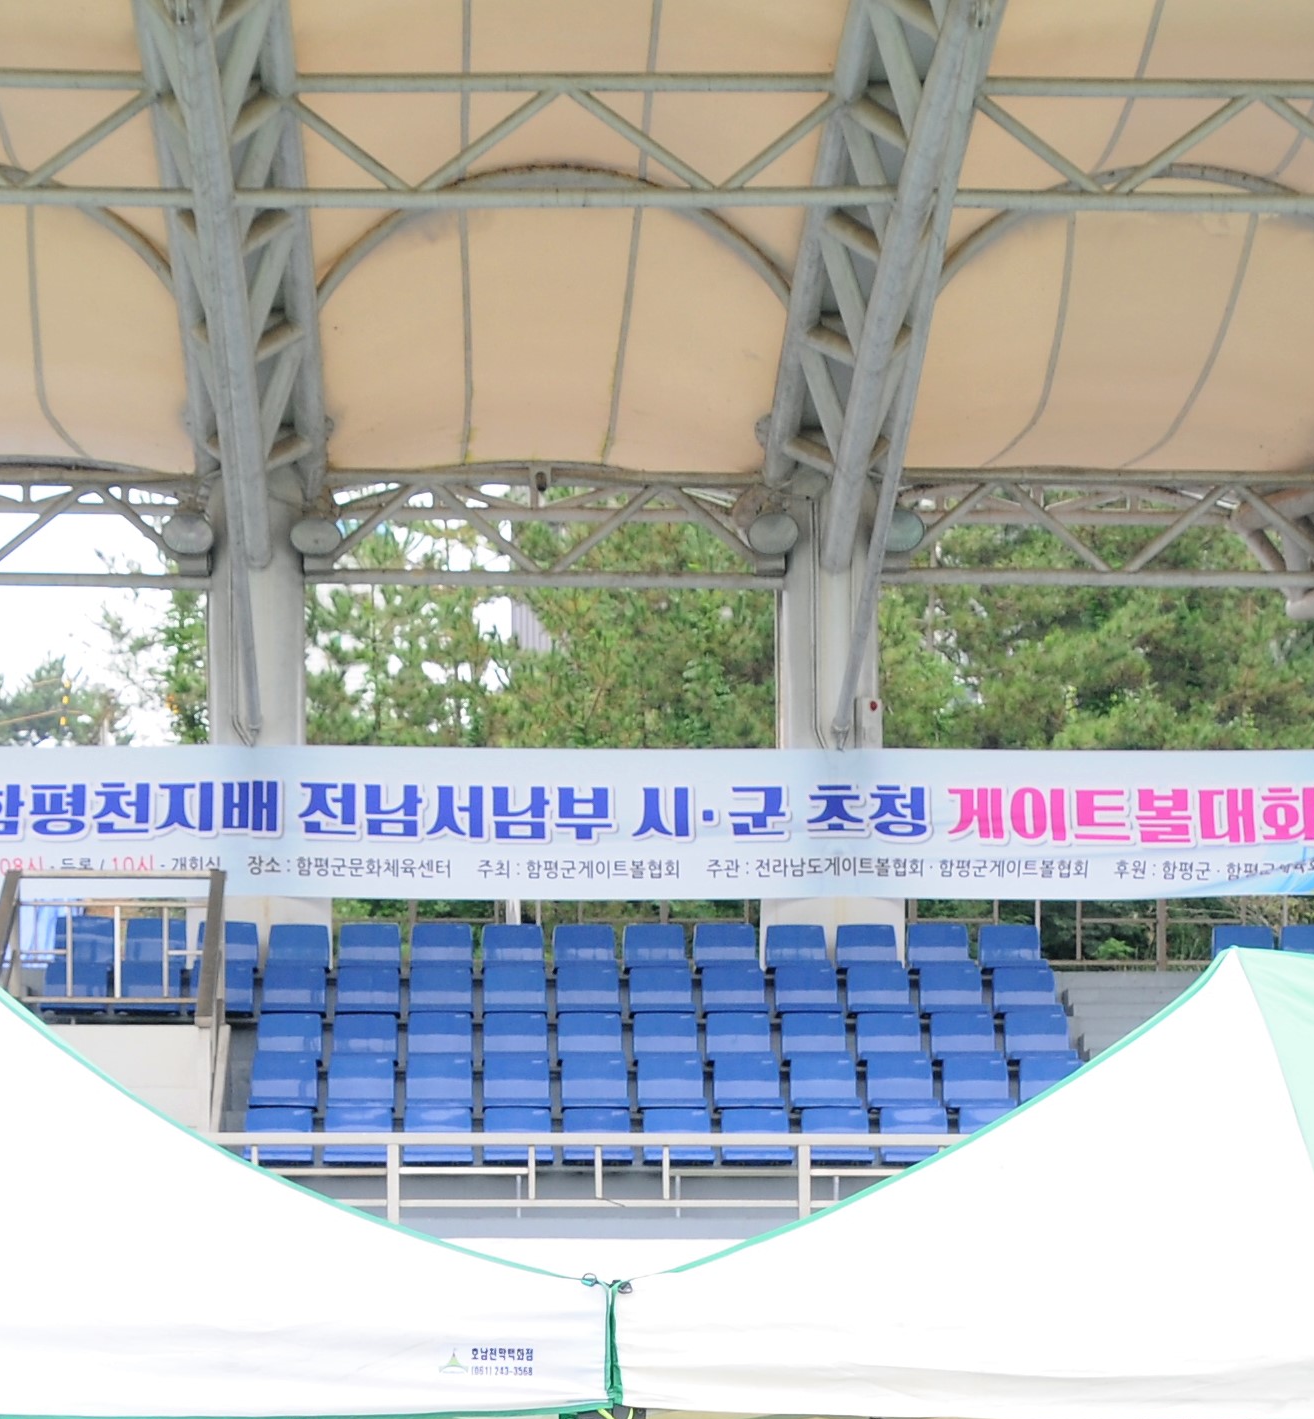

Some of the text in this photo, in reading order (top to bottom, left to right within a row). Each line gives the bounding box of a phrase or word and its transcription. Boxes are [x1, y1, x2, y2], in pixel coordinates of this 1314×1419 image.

[298, 782, 613, 840] 전남서남부
[806, 784, 927, 837] 초청
[247, 855, 282, 876] 장소
[297, 857, 452, 878] 함평군문화체육센터
[477, 859, 511, 879] 주최
[526, 859, 680, 879] 함평군게이트볼협회
[706, 858, 740, 878] 주관
[755, 856, 924, 878] 전라남도게이트볼협회
[939, 858, 1089, 879] 함평군게이트볼협회
[1114, 859, 1146, 880] 후원
[1162, 859, 1211, 881] 함평군
